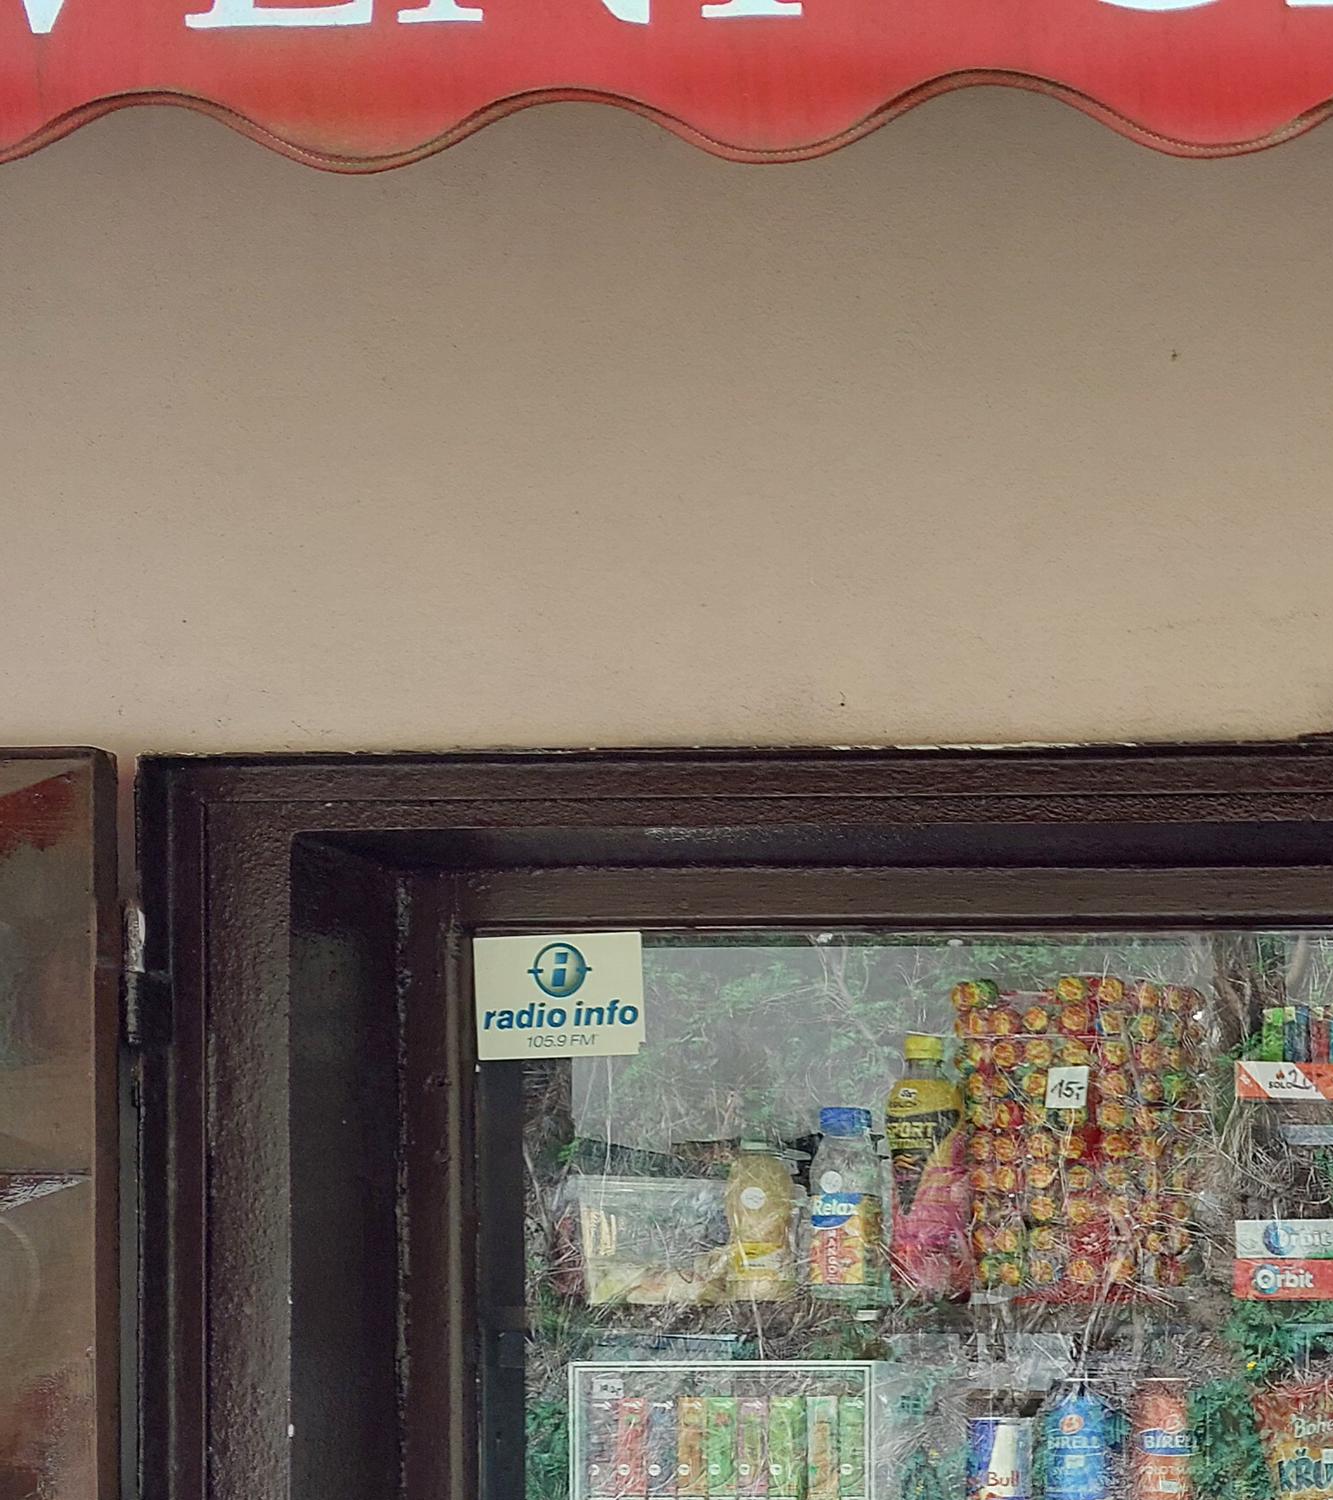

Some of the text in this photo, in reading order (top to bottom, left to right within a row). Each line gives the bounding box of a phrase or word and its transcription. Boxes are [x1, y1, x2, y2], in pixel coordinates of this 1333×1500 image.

[483, 1000, 639, 1031] radio info
[527, 1034, 595, 1048] 105.9 FM
[1255, 1265, 1314, 1290] Orbit
[987, 1472, 1019, 1487] Bull
